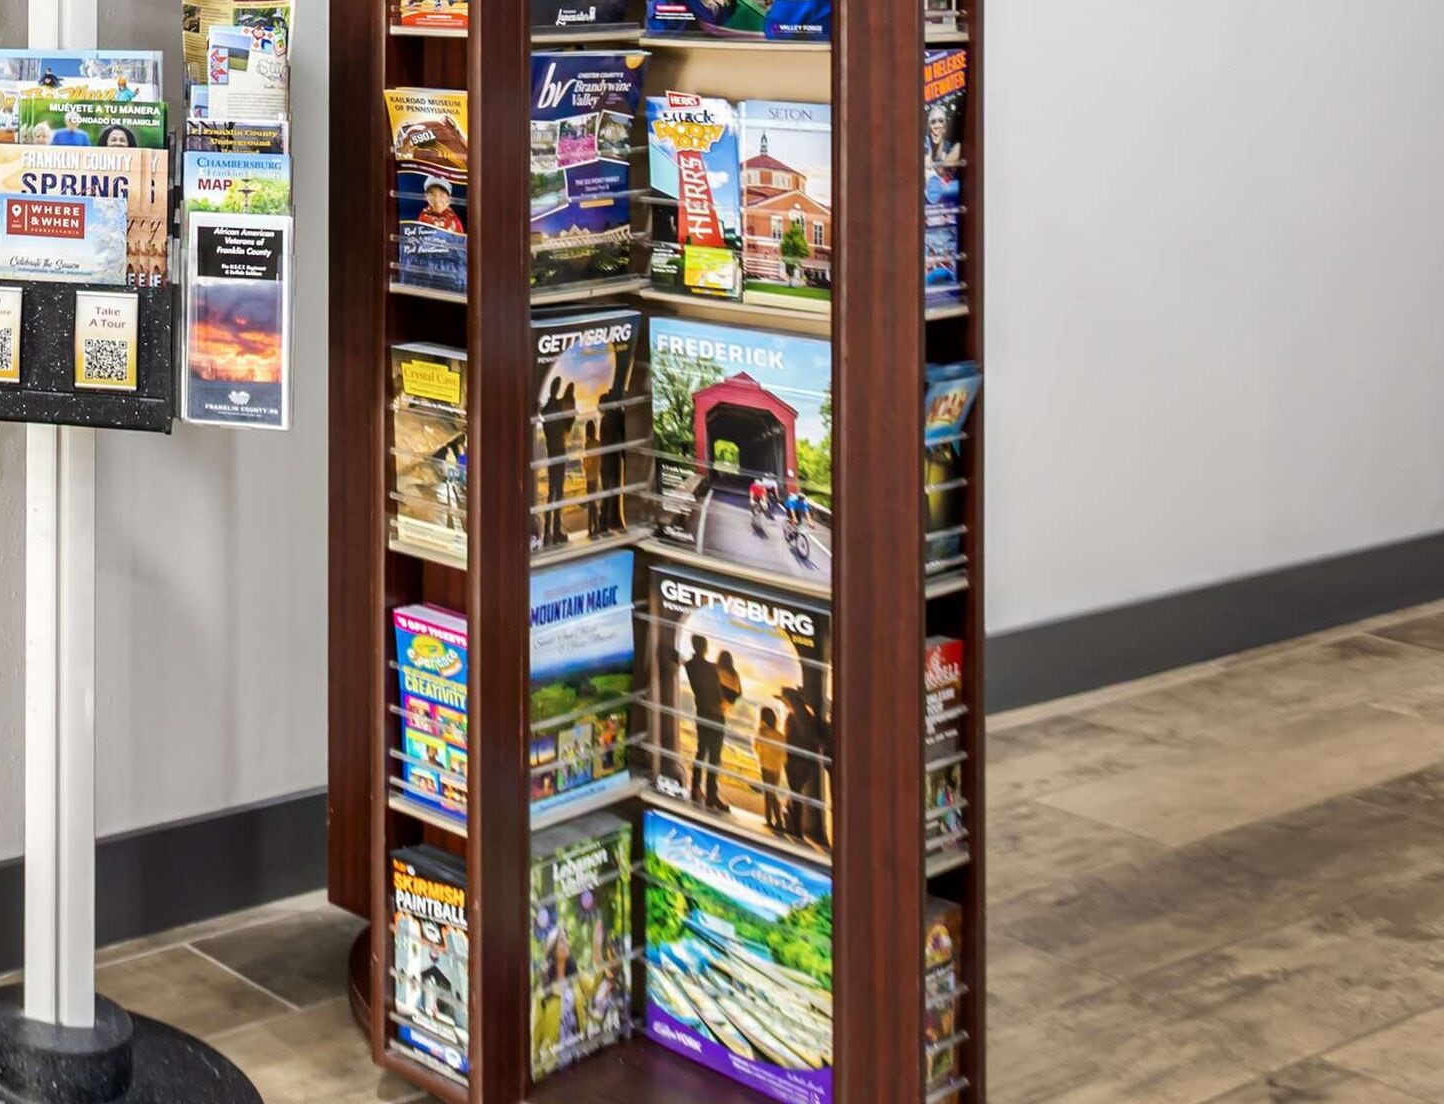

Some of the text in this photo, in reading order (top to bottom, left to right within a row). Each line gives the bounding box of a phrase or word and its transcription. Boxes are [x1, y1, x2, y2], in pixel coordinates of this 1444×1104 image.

[574, 79, 632, 96] Brandywine
[49, 103, 93, 113] MUÉVETE
[105, 105, 117, 113] TU
[119, 106, 160, 116] MANERA
[390, 96, 462, 108] RAILROAD MUSEUM
[572, 94, 601, 110] Valley
[768, 107, 813, 122] SETON
[22, 152, 132, 172] FRANKLIN COUNTY
[197, 157, 282, 170] CHAMBERSBURG
[21, 172, 129, 198] SPRING
[198, 179, 233, 191] MAP
[30, 204, 80, 216] WHERE
[41, 217, 80, 228] WHEN
[95, 306, 121, 317] Take
[89, 319, 126, 329] A Tour
[538, 324, 632, 354] GETTYSBURG
[656, 333, 785, 370] FREDERICK
[404, 366, 436, 382] Crystal
[529, 584, 619, 627] MOUNTAIN MAGIC
[660, 579, 815, 637] GETTYSBURG
[404, 674, 467, 710] CREATIVITY
[393, 871, 466, 908] SKIRMISH
[395, 890, 468, 925] PAINTBALL
